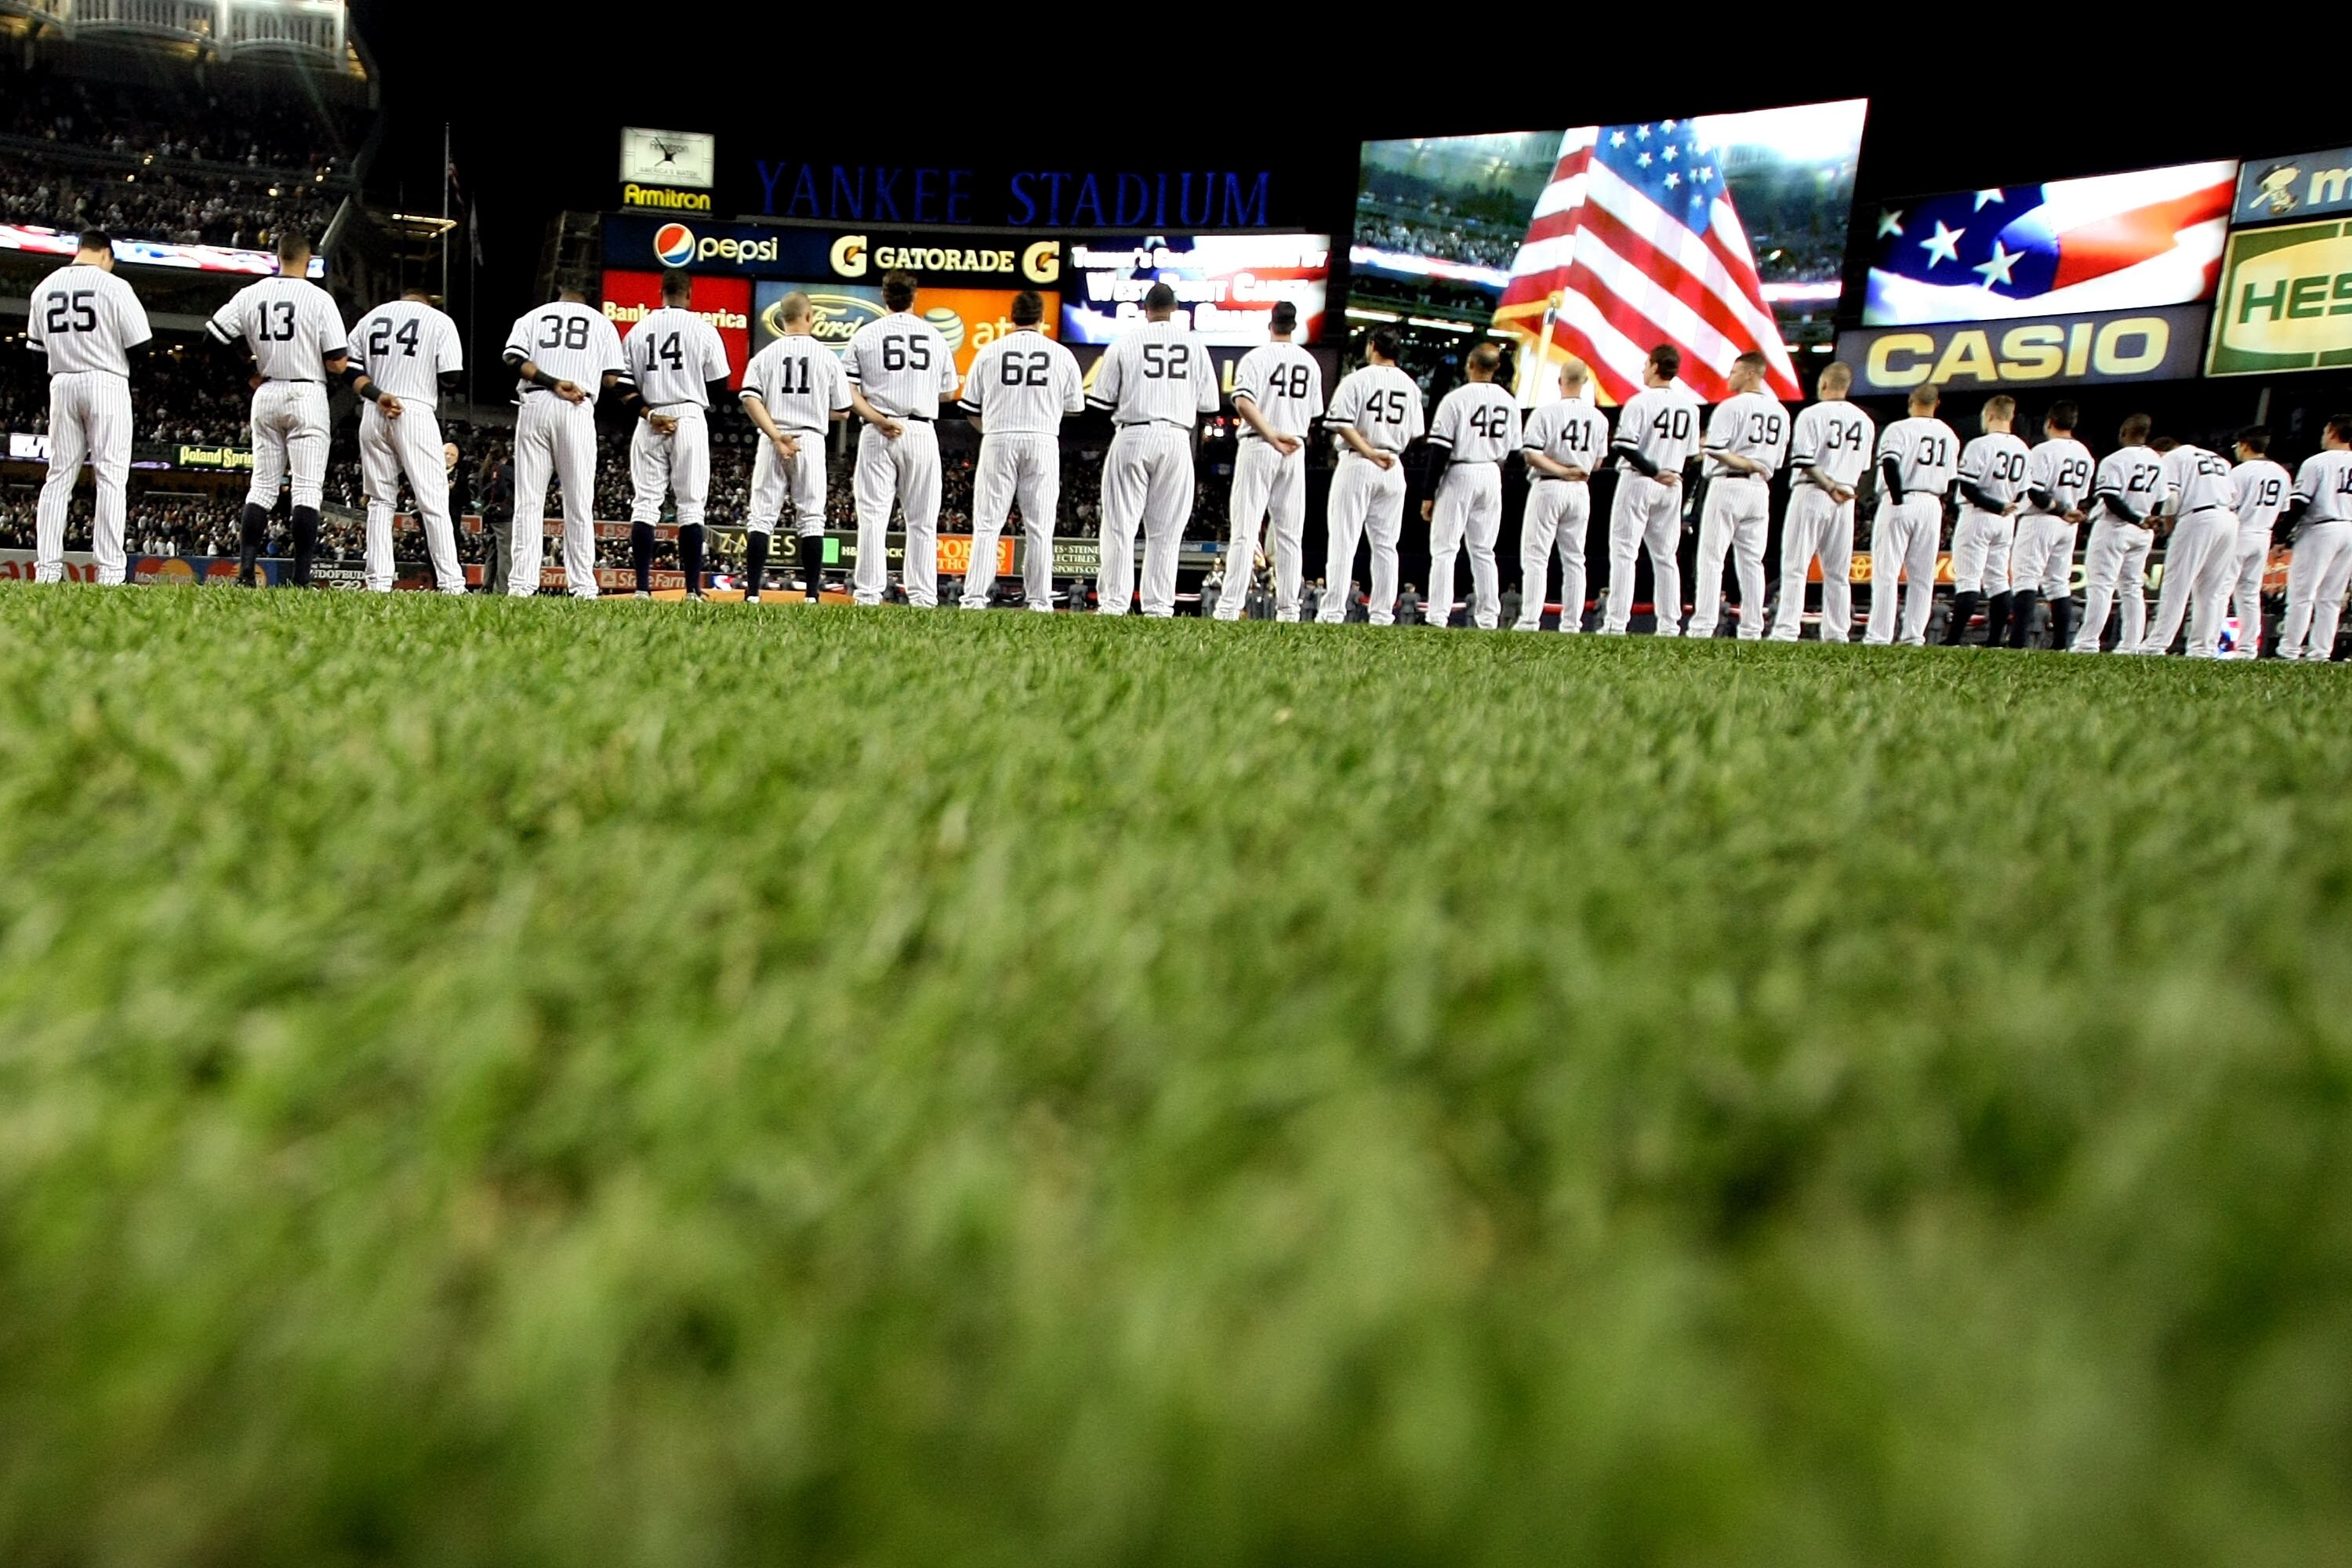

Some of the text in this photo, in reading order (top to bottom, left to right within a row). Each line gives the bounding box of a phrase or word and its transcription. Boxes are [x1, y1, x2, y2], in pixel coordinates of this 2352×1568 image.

[624, 183, 711, 211] Armitron
[755, 159, 1271, 227] YANKEE STADIUM
[698, 237, 778, 265] pepsi
[874, 246, 1015, 272] GATORADE
[47, 289, 96, 334] 25
[257, 300, 296, 342] 13
[602, 301, 650, 322] Bank
[369, 316, 419, 357] 24
[539, 314, 590, 350] 38
[645, 330, 683, 371] 14
[882, 335, 931, 371] 65
[1142, 343, 1189, 379] 52
[1866, 316, 2169, 387] CASIO
[782, 356, 810, 394] 11
[1001, 350, 1051, 387] 62
[1269, 362, 1310, 399] 48
[1366, 389, 1406, 424] 45
[1470, 405, 1509, 438] 42
[1561, 419, 1592, 452] 41
[1653, 407, 1690, 440] 40
[1748, 412, 1781, 445] 39
[1827, 419, 1863, 451] 34
[180, 445, 252, 468] Poland Sprin
[1917, 436, 1947, 467] 31
[1992, 451, 2026, 482] 30
[2057, 458, 2088, 488] 29
[2128, 463, 2161, 493] 27
[2256, 478, 2281, 506] 19
[718, 532, 797, 557] ZAES
[619, 572, 653, 587] Stae
